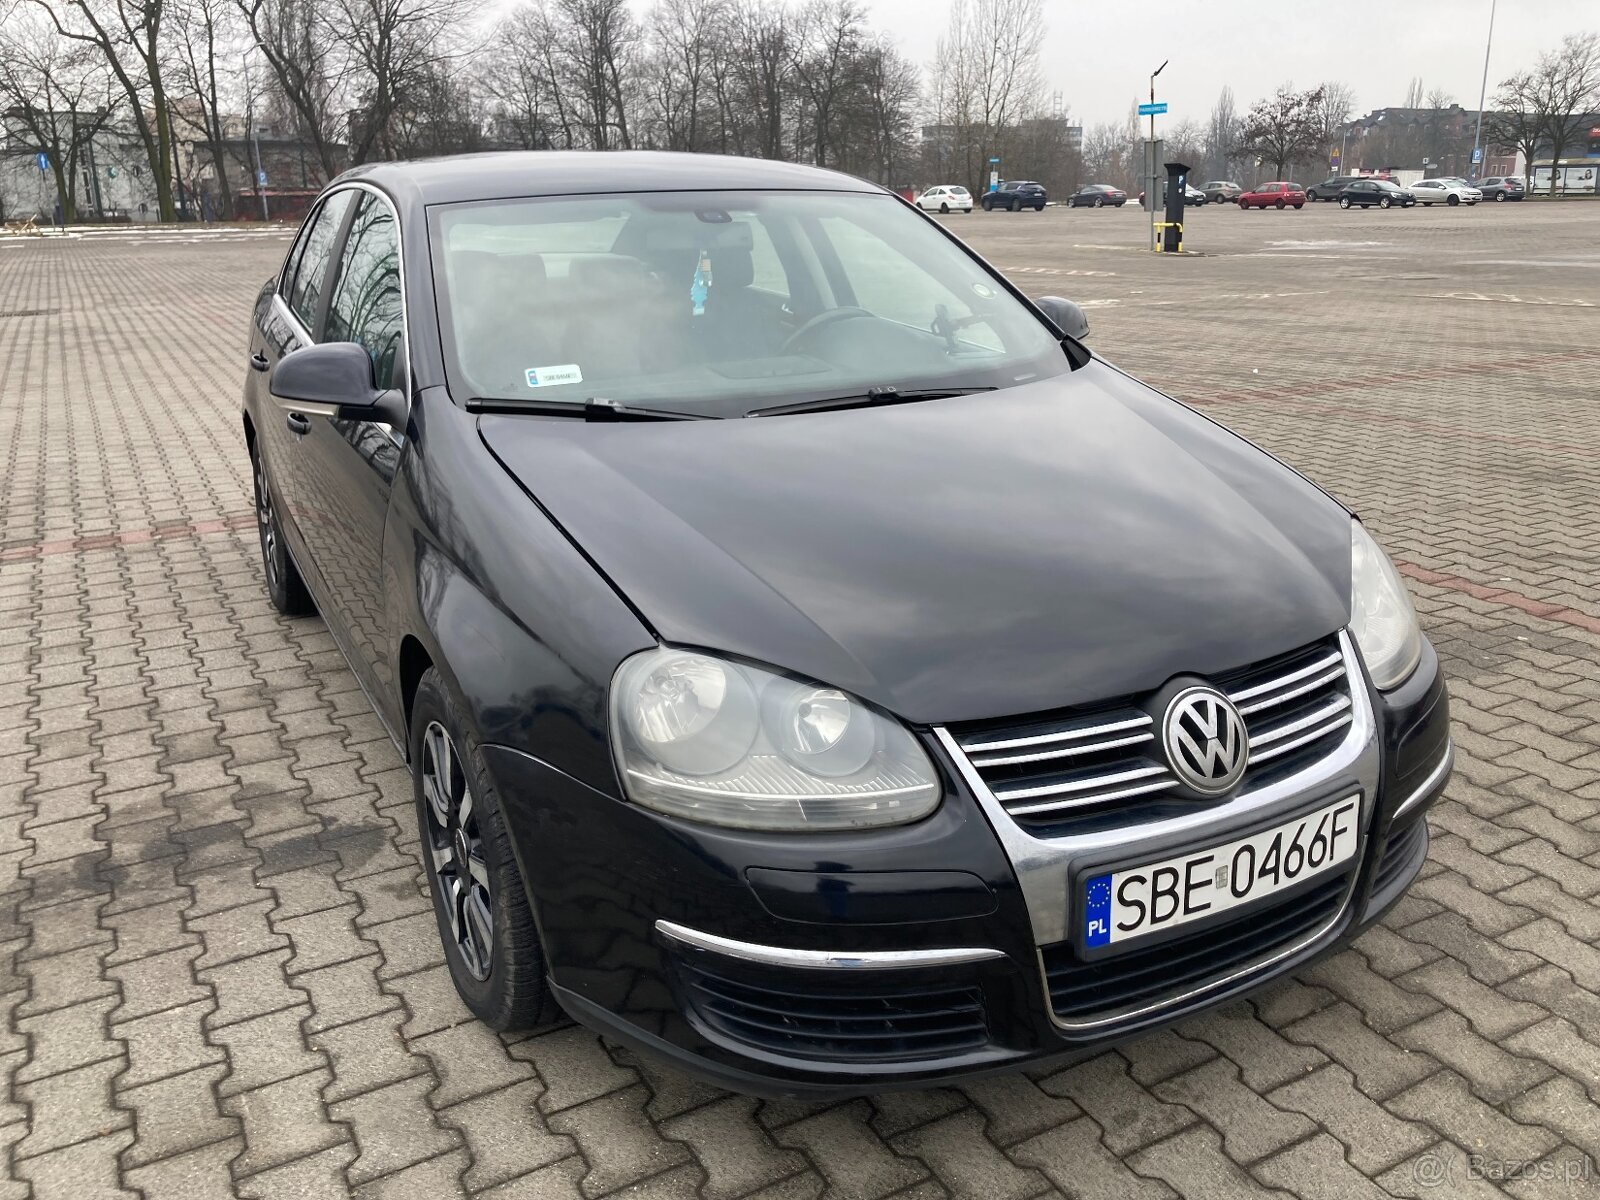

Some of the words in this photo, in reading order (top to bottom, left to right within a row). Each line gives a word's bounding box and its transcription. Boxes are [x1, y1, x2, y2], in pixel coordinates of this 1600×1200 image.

[1117, 854, 1215, 932] SBE
[1231, 802, 1355, 899] 0466F
[1088, 919, 1107, 937] PL
